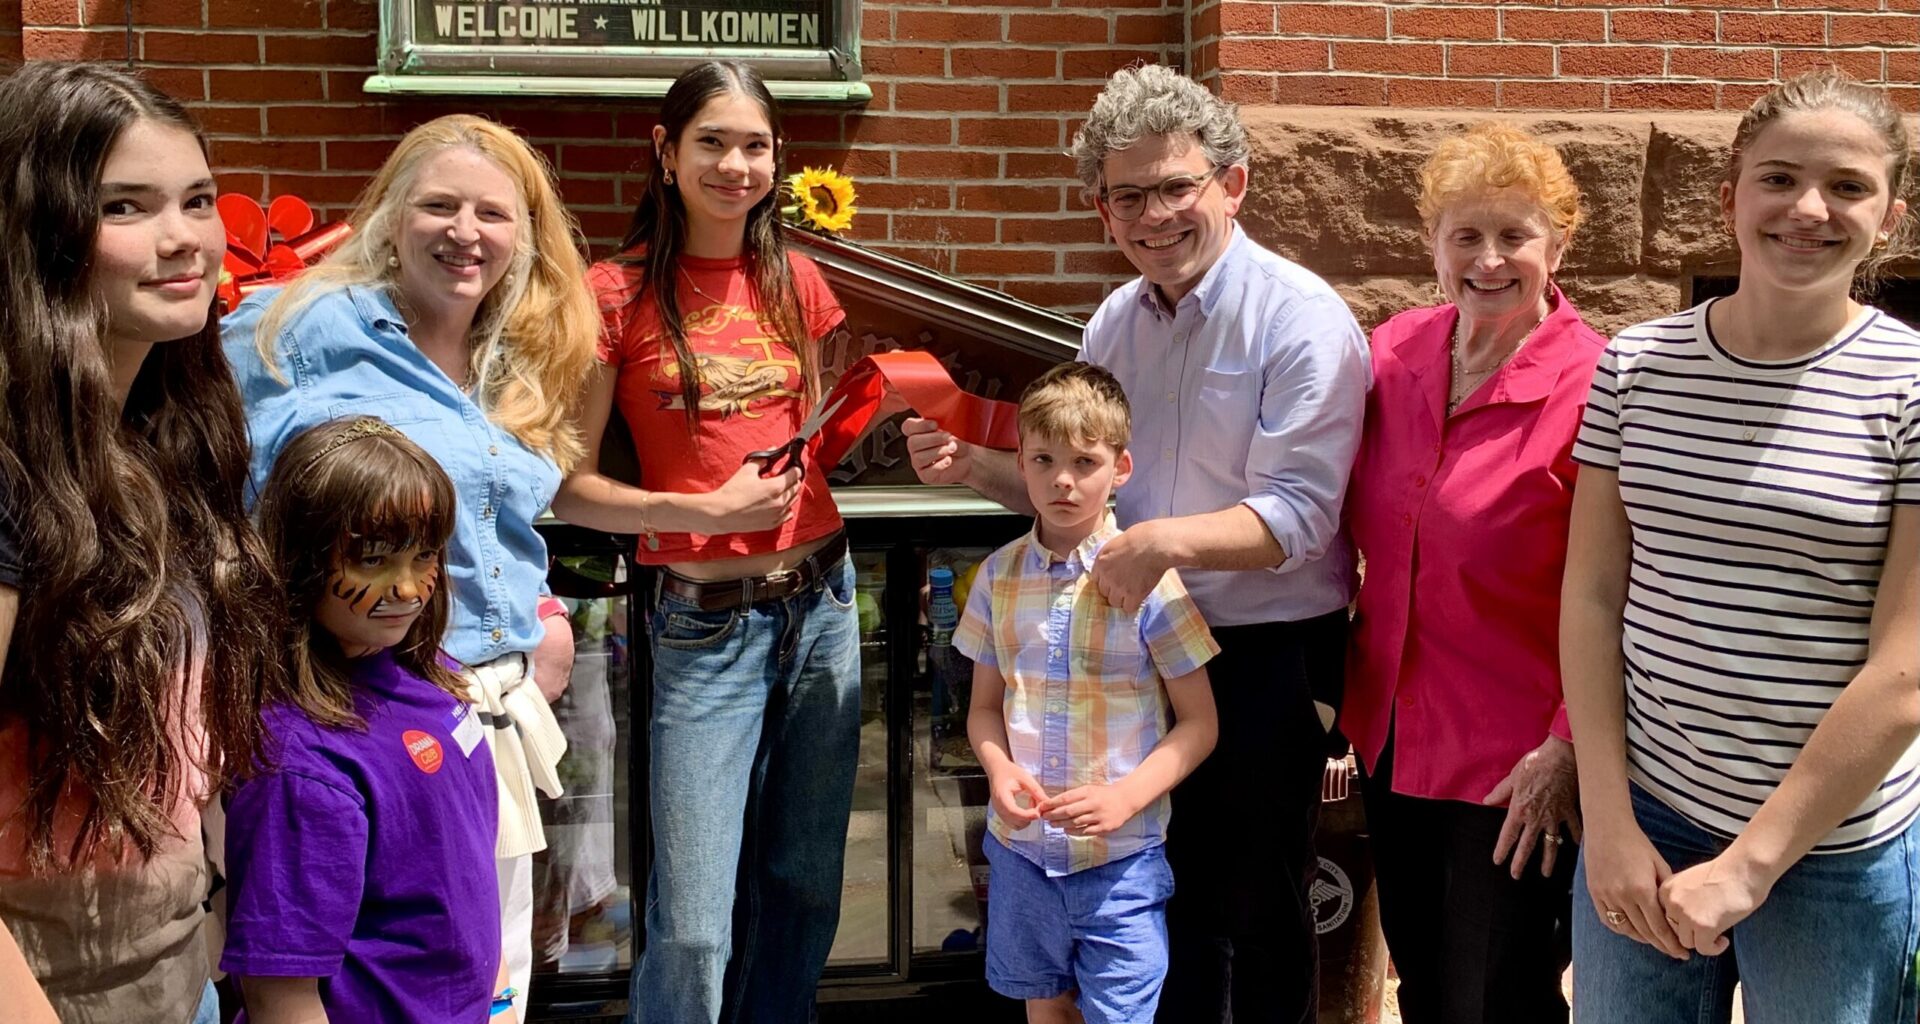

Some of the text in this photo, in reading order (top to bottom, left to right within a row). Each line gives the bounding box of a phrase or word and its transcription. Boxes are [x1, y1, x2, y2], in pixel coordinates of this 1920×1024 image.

[434, 5, 819, 45] WELCOME WILLKOMMEN
[408, 735, 437, 756] DRAMA
[1323, 862, 1339, 875] CITY
[1317, 902, 1349, 931] SANITATION
